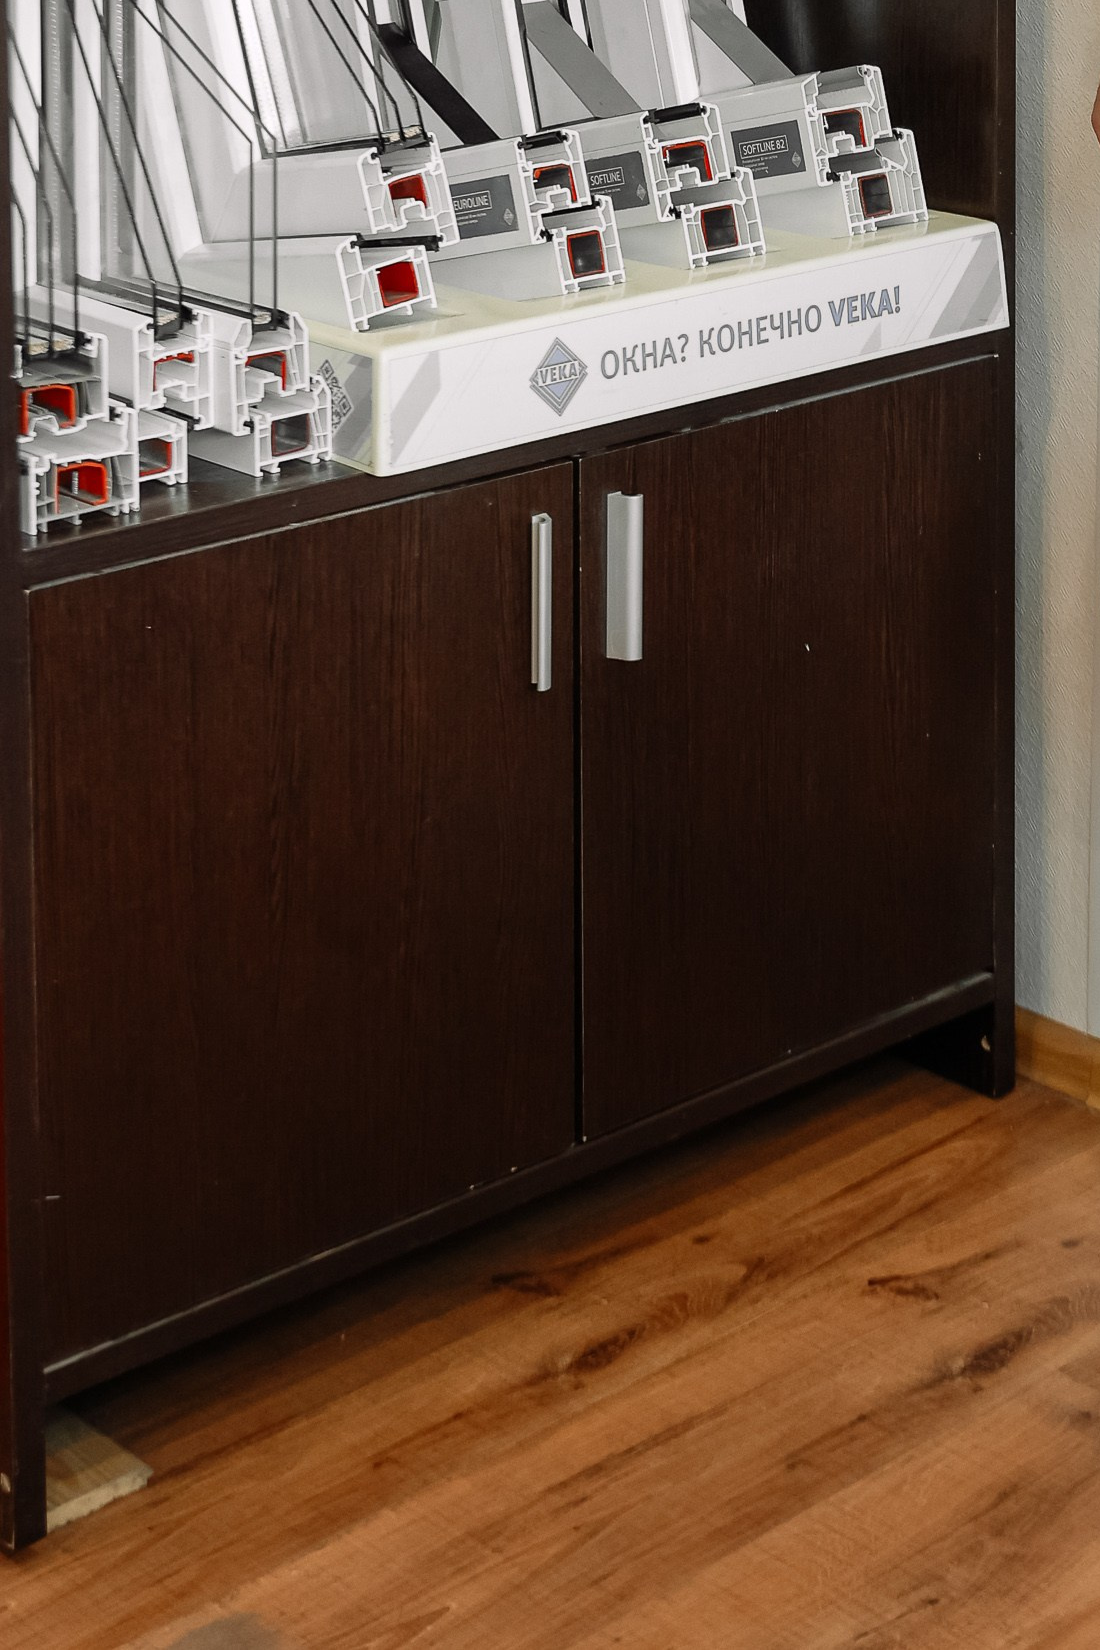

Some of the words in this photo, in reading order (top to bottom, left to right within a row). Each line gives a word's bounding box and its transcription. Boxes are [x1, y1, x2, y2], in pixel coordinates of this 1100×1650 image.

[742, 140, 776, 156] SOFTLINE
[775, 139, 786, 150] 82
[590, 171, 622, 186] SOFTLINE
[453, 195, 489, 211] EUROLINE
[600, 333, 689, 380] ОКНА?
[699, 304, 822, 358] КОНЕЧНО
[828, 285, 901, 327] VEKA!
[538, 362, 580, 386] VEKA
